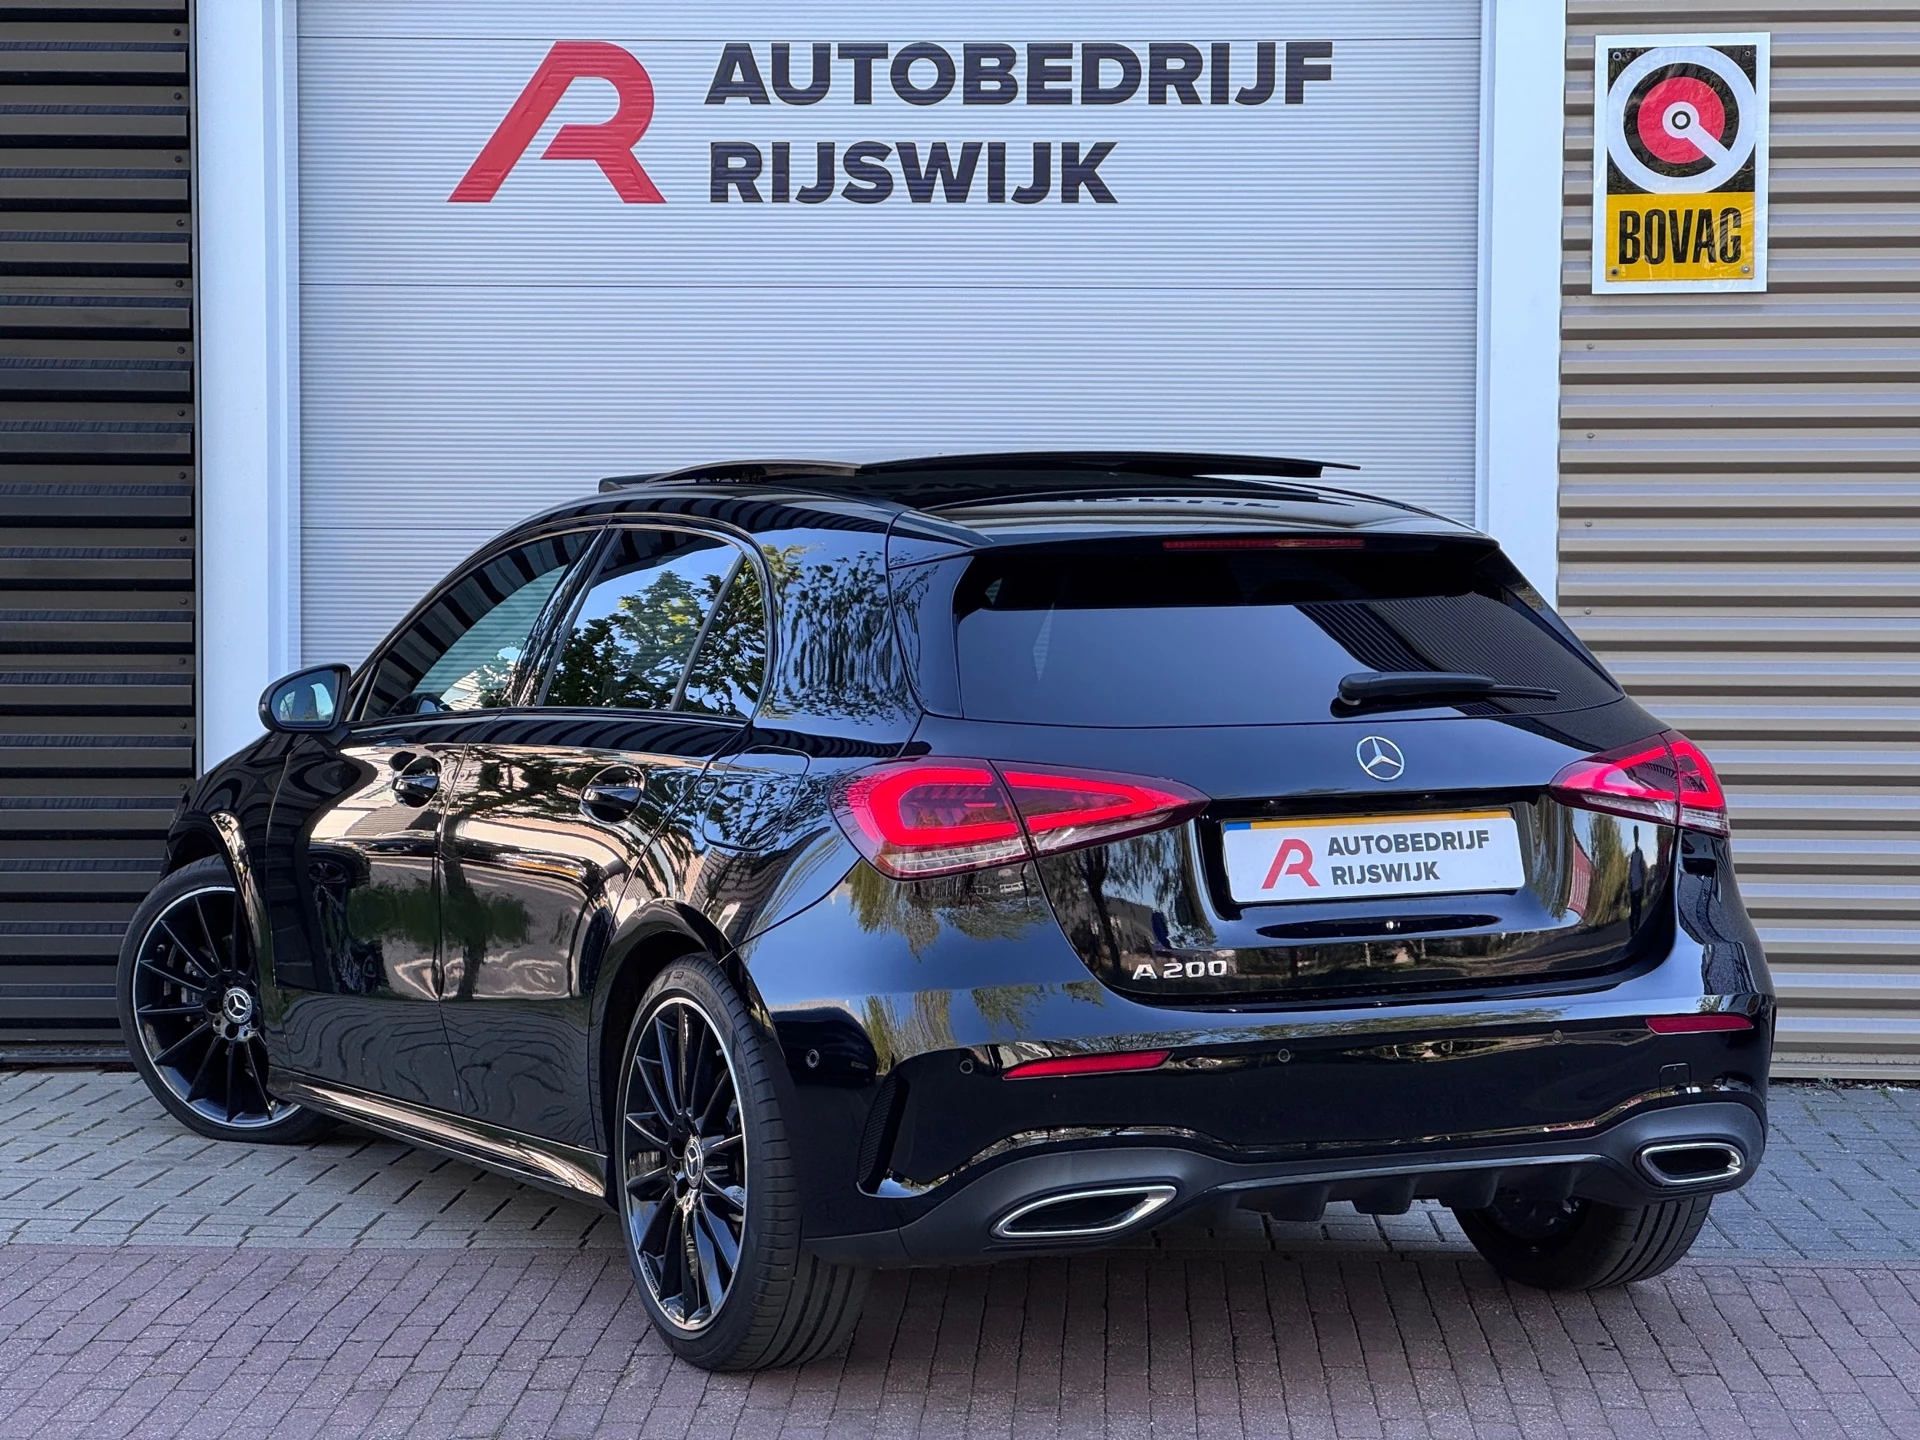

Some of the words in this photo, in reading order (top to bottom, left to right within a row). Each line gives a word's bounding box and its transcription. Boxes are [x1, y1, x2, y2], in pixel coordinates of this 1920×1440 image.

[704, 42, 1333, 105] AUTOBEDRIJF
[710, 141, 1118, 204] RIJSWIJK
[1618, 207, 1742, 265] BOVAG
[1327, 830, 1489, 857] AUTOBEDRIJF
[1331, 861, 1440, 885] RIJSWIJK
[1132, 964, 1157, 980] A
[1163, 960, 1227, 979] 200
